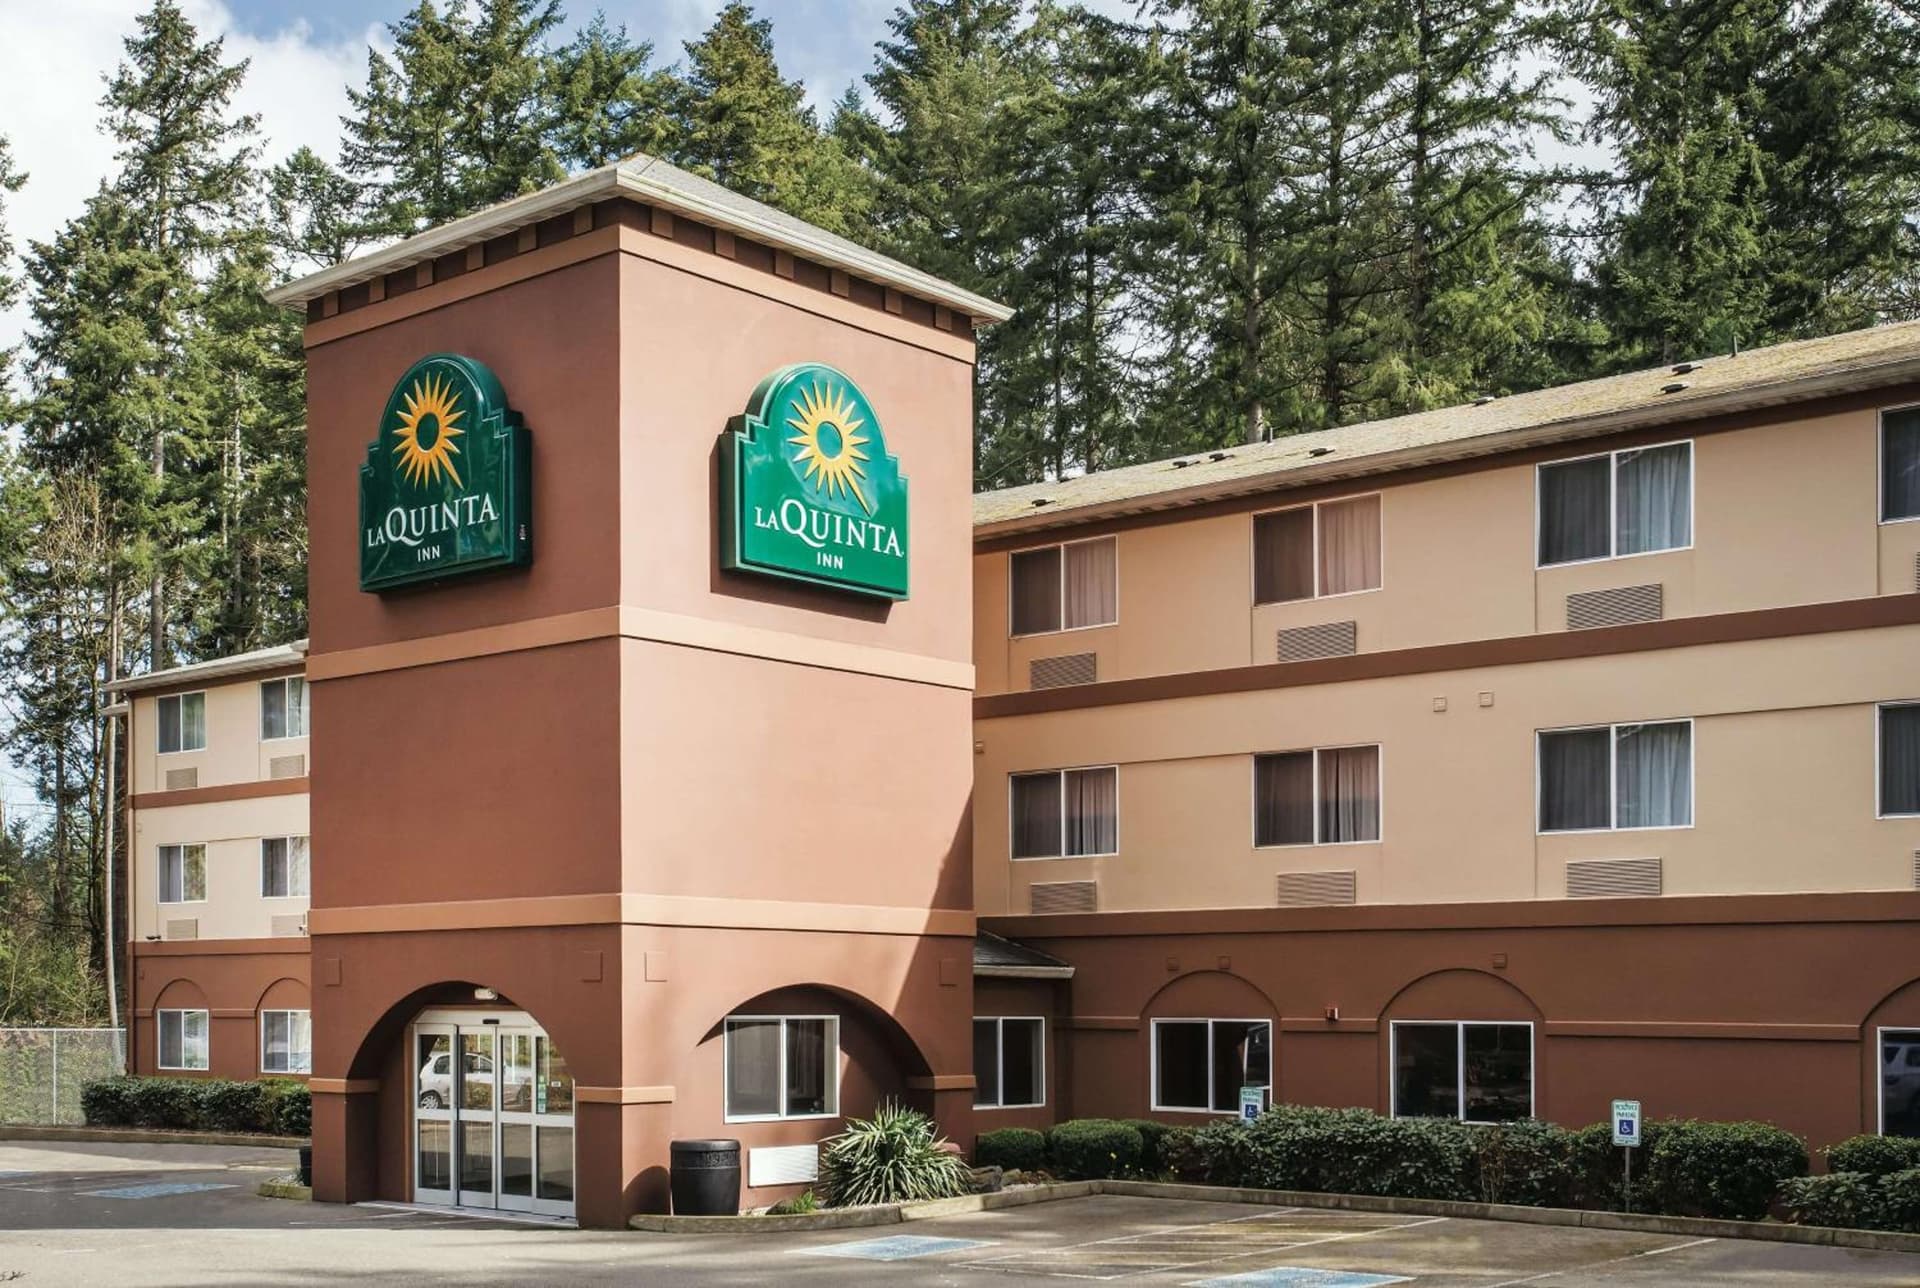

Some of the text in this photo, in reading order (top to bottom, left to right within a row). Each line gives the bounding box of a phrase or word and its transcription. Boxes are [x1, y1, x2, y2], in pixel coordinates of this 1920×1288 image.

[385, 492, 499, 546] QUINTA
[780, 499, 903, 558] QUINTA
[417, 545, 440, 562] INN
[816, 552, 844, 570] INN
